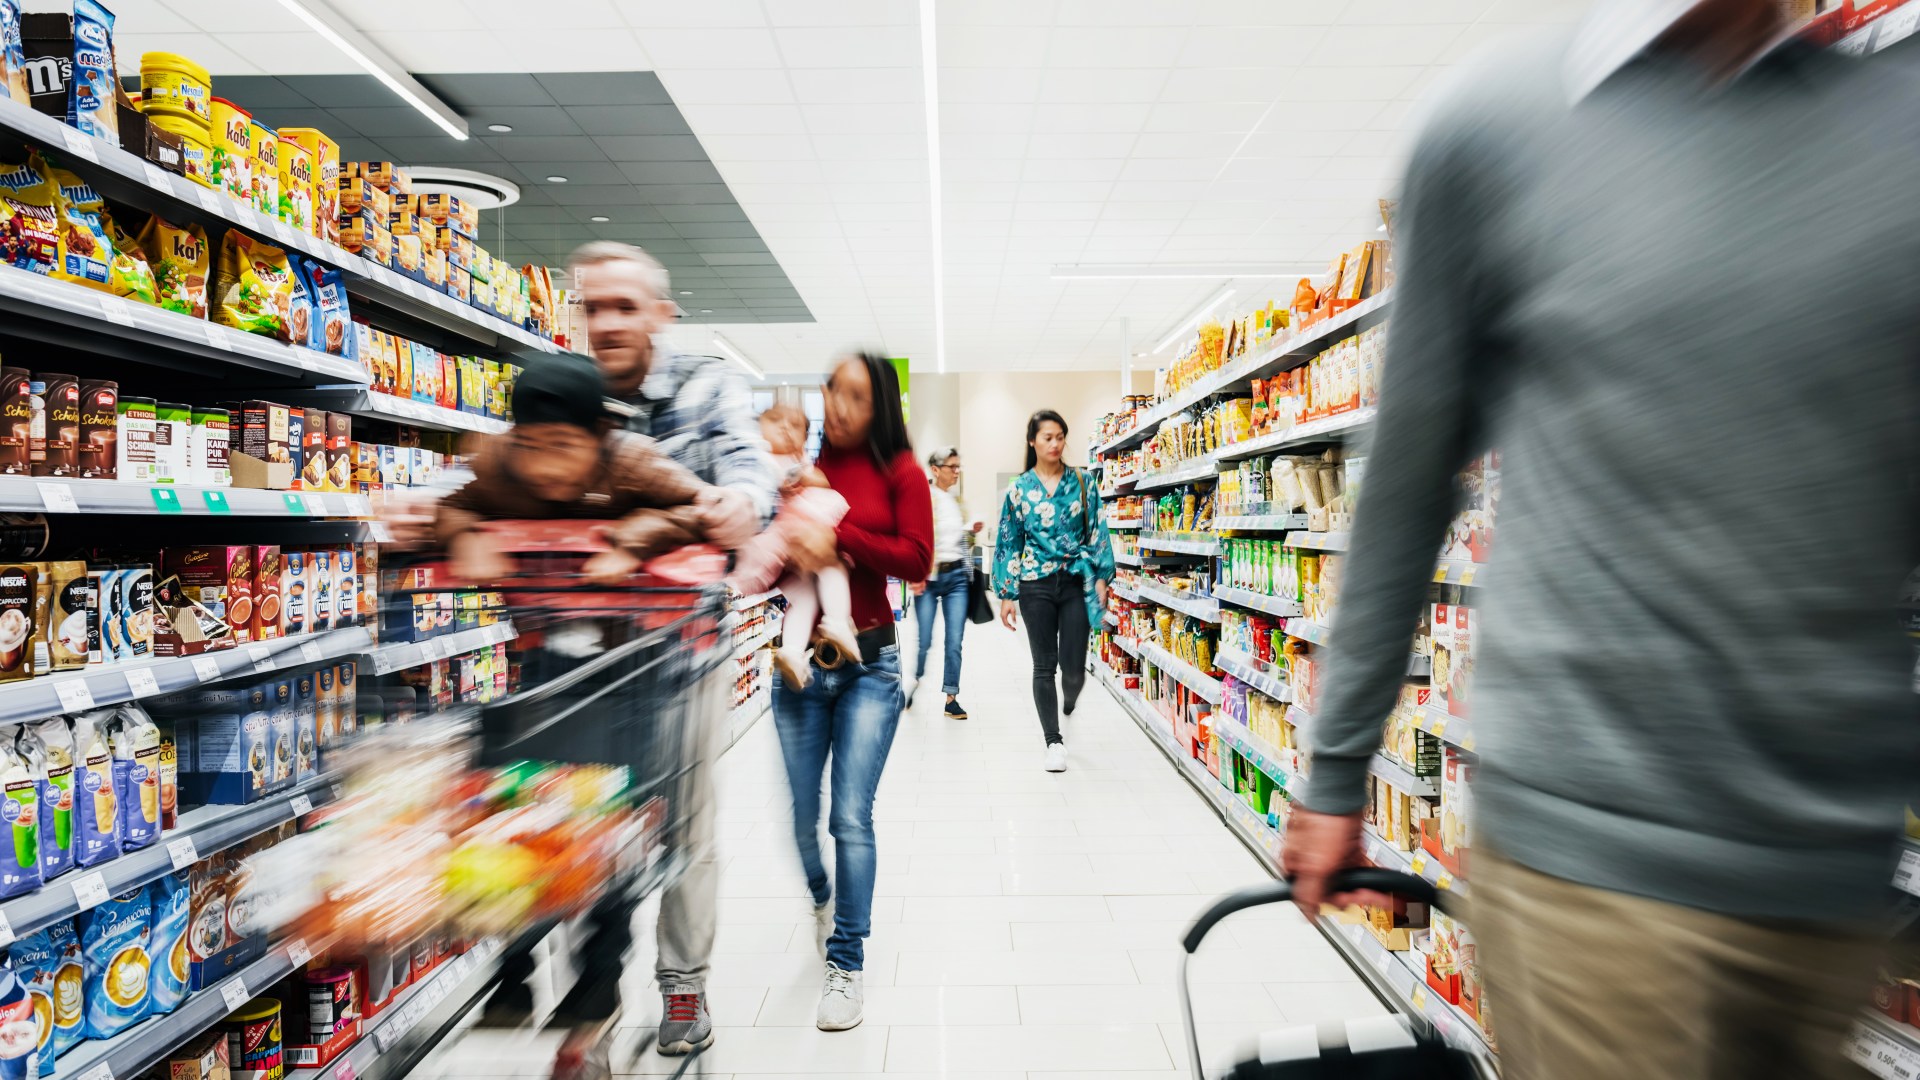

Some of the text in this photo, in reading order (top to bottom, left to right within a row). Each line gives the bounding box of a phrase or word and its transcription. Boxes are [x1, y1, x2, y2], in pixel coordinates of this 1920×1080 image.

[181, 83, 204, 99] Nesquik
[184, 147, 204, 159] Nesquik
[321, 166, 339, 181] Choco
[25, 229, 34, 237] IN
[128, 431, 150, 441] TRINK
[207, 449, 223, 458] PUR
[246, 1026, 256, 1038] GUT
[1877, 1050, 1897, 1068] 0,50€
